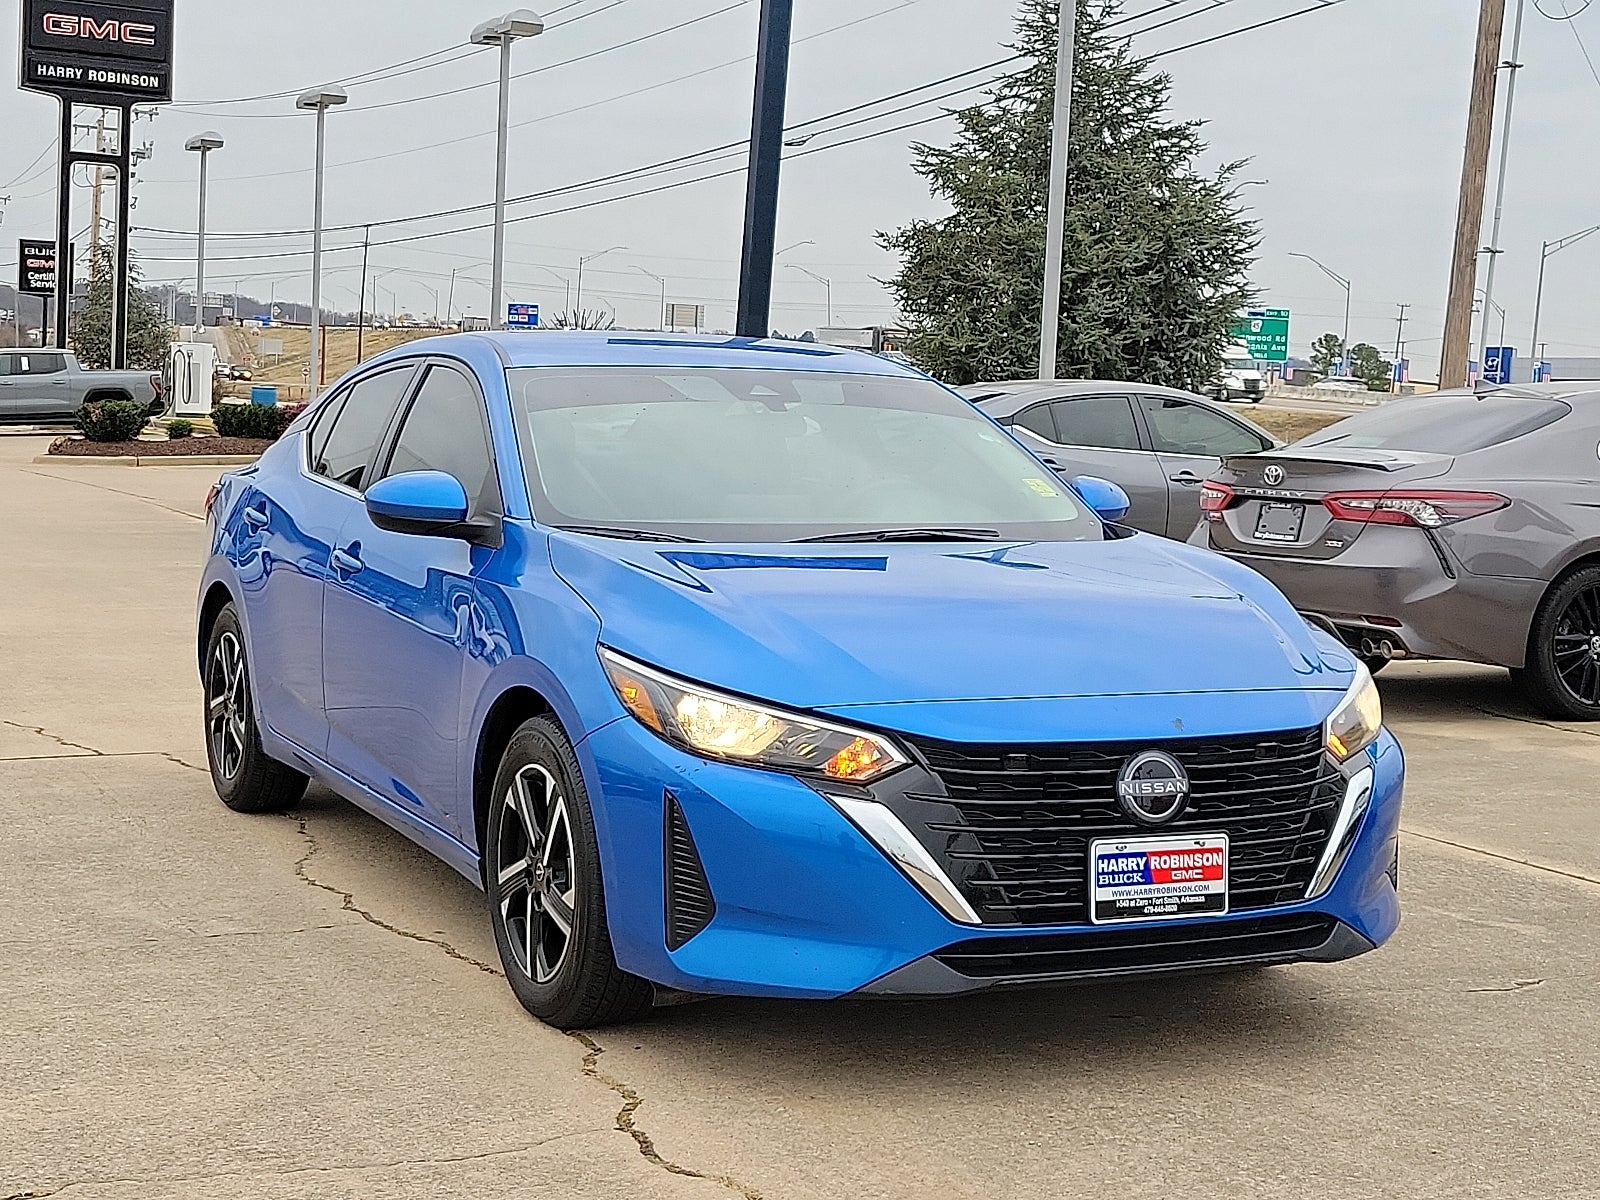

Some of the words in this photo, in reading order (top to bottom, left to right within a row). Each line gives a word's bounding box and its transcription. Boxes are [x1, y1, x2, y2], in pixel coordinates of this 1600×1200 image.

[44, 13, 155, 45] GMC
[37, 63, 83, 80] HARRY
[88, 70, 159, 88] ROBINSON
[24, 247, 56, 256] BUIC
[26, 258, 55, 268] GM
[27, 271, 55, 281] Certifi
[30, 280, 56, 288] Servic
[1252, 322, 1260, 330] 45
[1121, 781, 1187, 794] NISSAN
[1098, 856, 1148, 873] HARRY
[1150, 851, 1223, 869] ROBINSON
[1098, 872, 1144, 885] BUICK
[1171, 869, 1204, 880] GMC
[1111, 884, 1210, 898] WWW.HARRYROBINSON.COM
[1152, 897, 1163, 905] Fort
[1181, 895, 1206, 903] Arkansas
